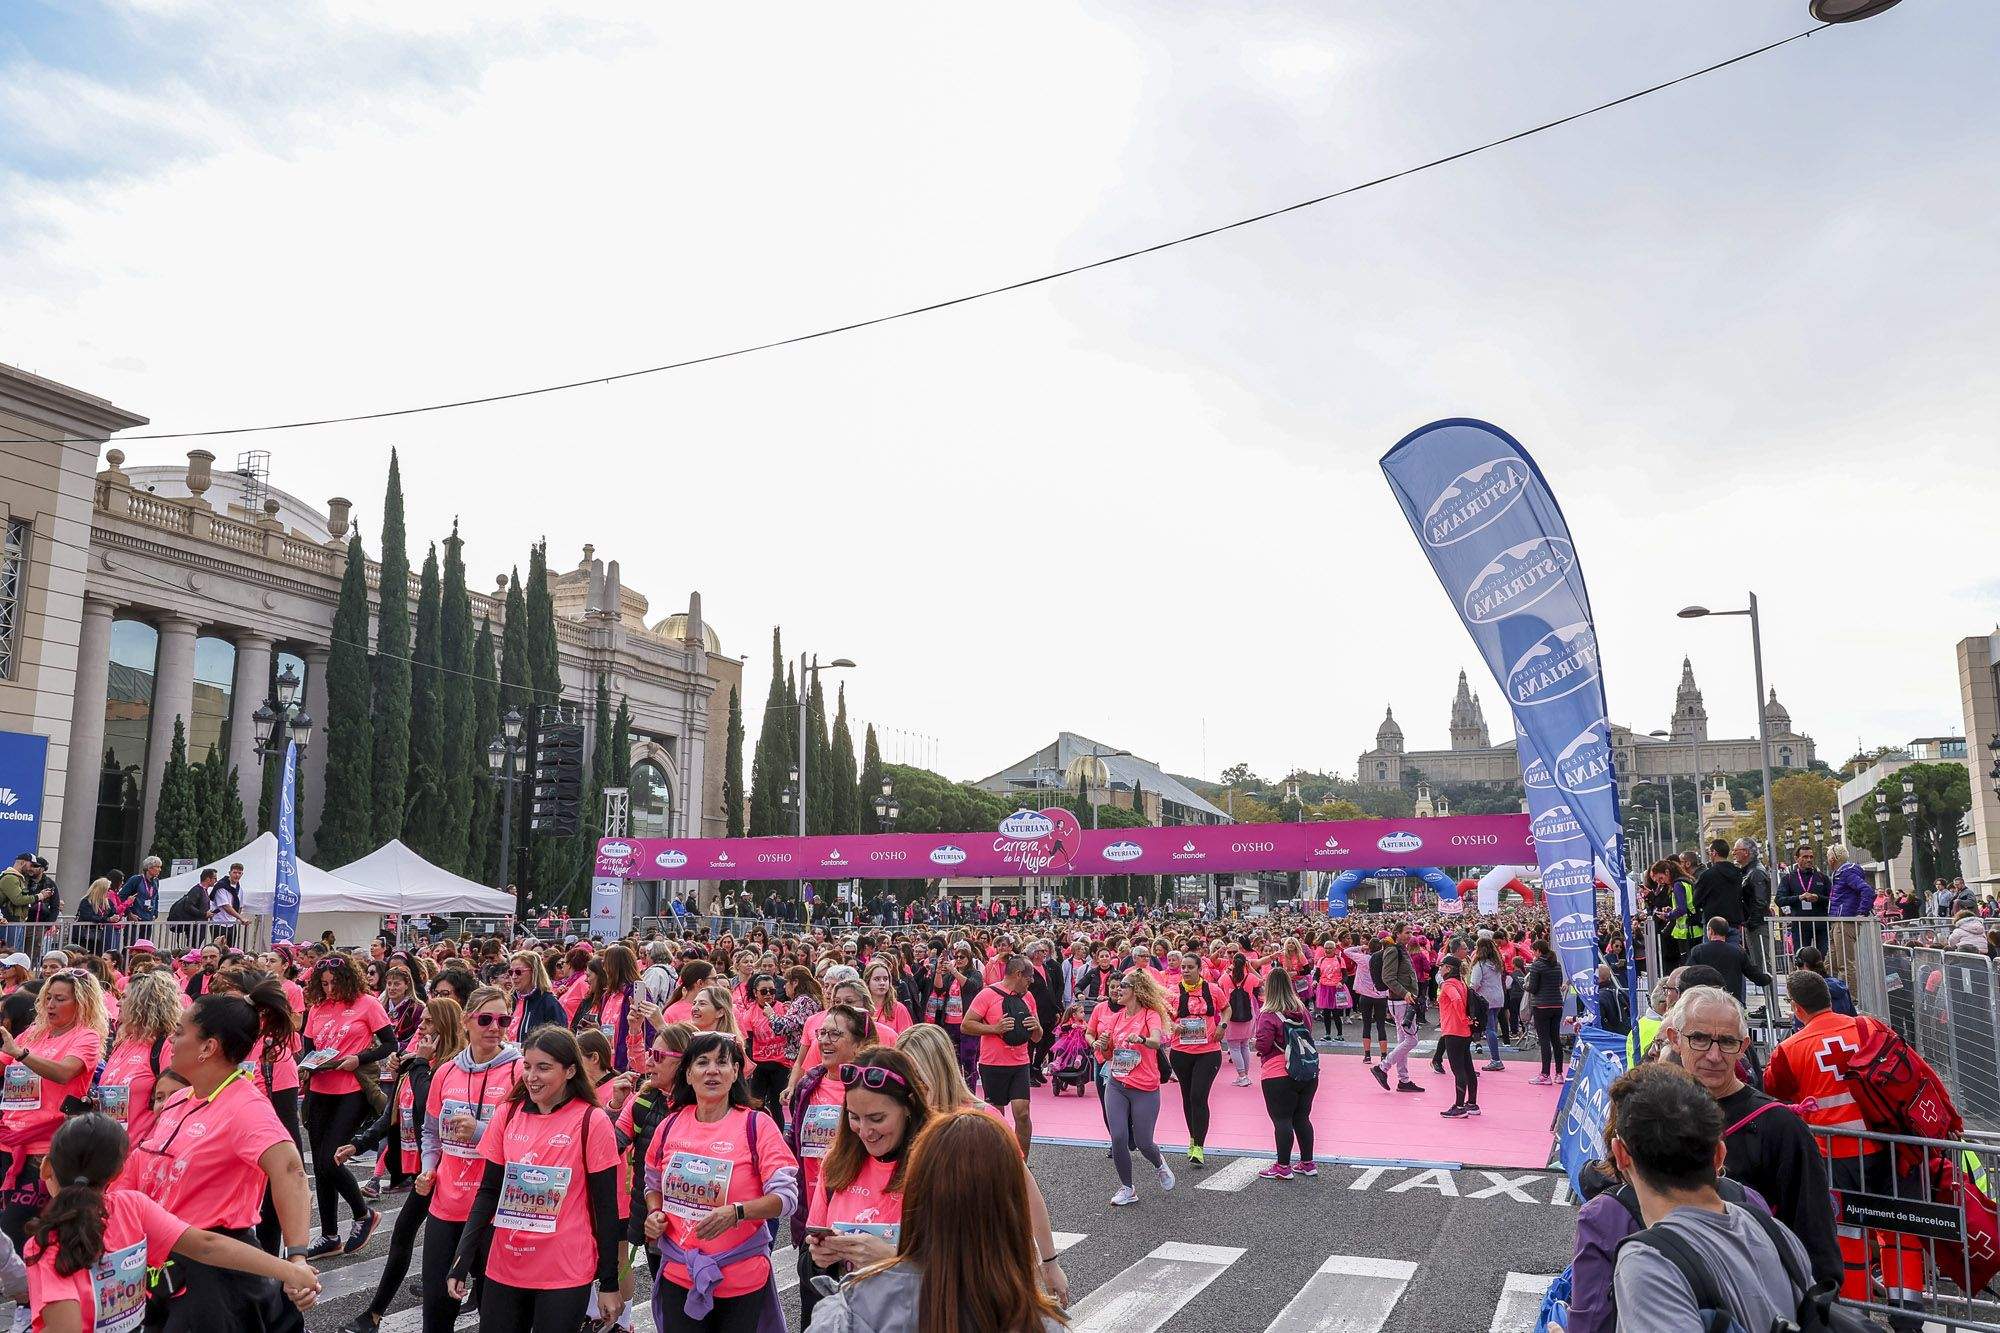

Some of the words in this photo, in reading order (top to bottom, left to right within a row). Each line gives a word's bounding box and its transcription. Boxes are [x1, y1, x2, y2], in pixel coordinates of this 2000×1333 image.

[0, 811, 34, 821] rcelona
[1003, 822, 1050, 833] ASTURIANA
[1381, 840, 1420, 848] ASTURIANA
[1451, 834, 1498, 846] OYSHO
[1231, 842, 1274, 853] OYSHO
[1314, 847, 1350, 856] Santander
[758, 853, 792, 862] OYSHO
[870, 851, 907, 861] OYSHO
[932, 852, 965, 860] ASTURIANA
[1105, 849, 1141, 857] ASTURIANA
[1172, 852, 1206, 860] Santander
[821, 859, 849, 867] Santander
[1018, 851, 1055, 874] Mujer
[591, 929, 618, 938] OYSHO
[682, 1182, 706, 1197] 016
[1347, 1164, 1572, 1206] TAXI
[521, 1193, 545, 1206] 016
[1846, 1204, 1896, 1219] Ajuntament
[1896, 1211, 1908, 1221] de
[1909, 1213, 1956, 1228] Barcelona
